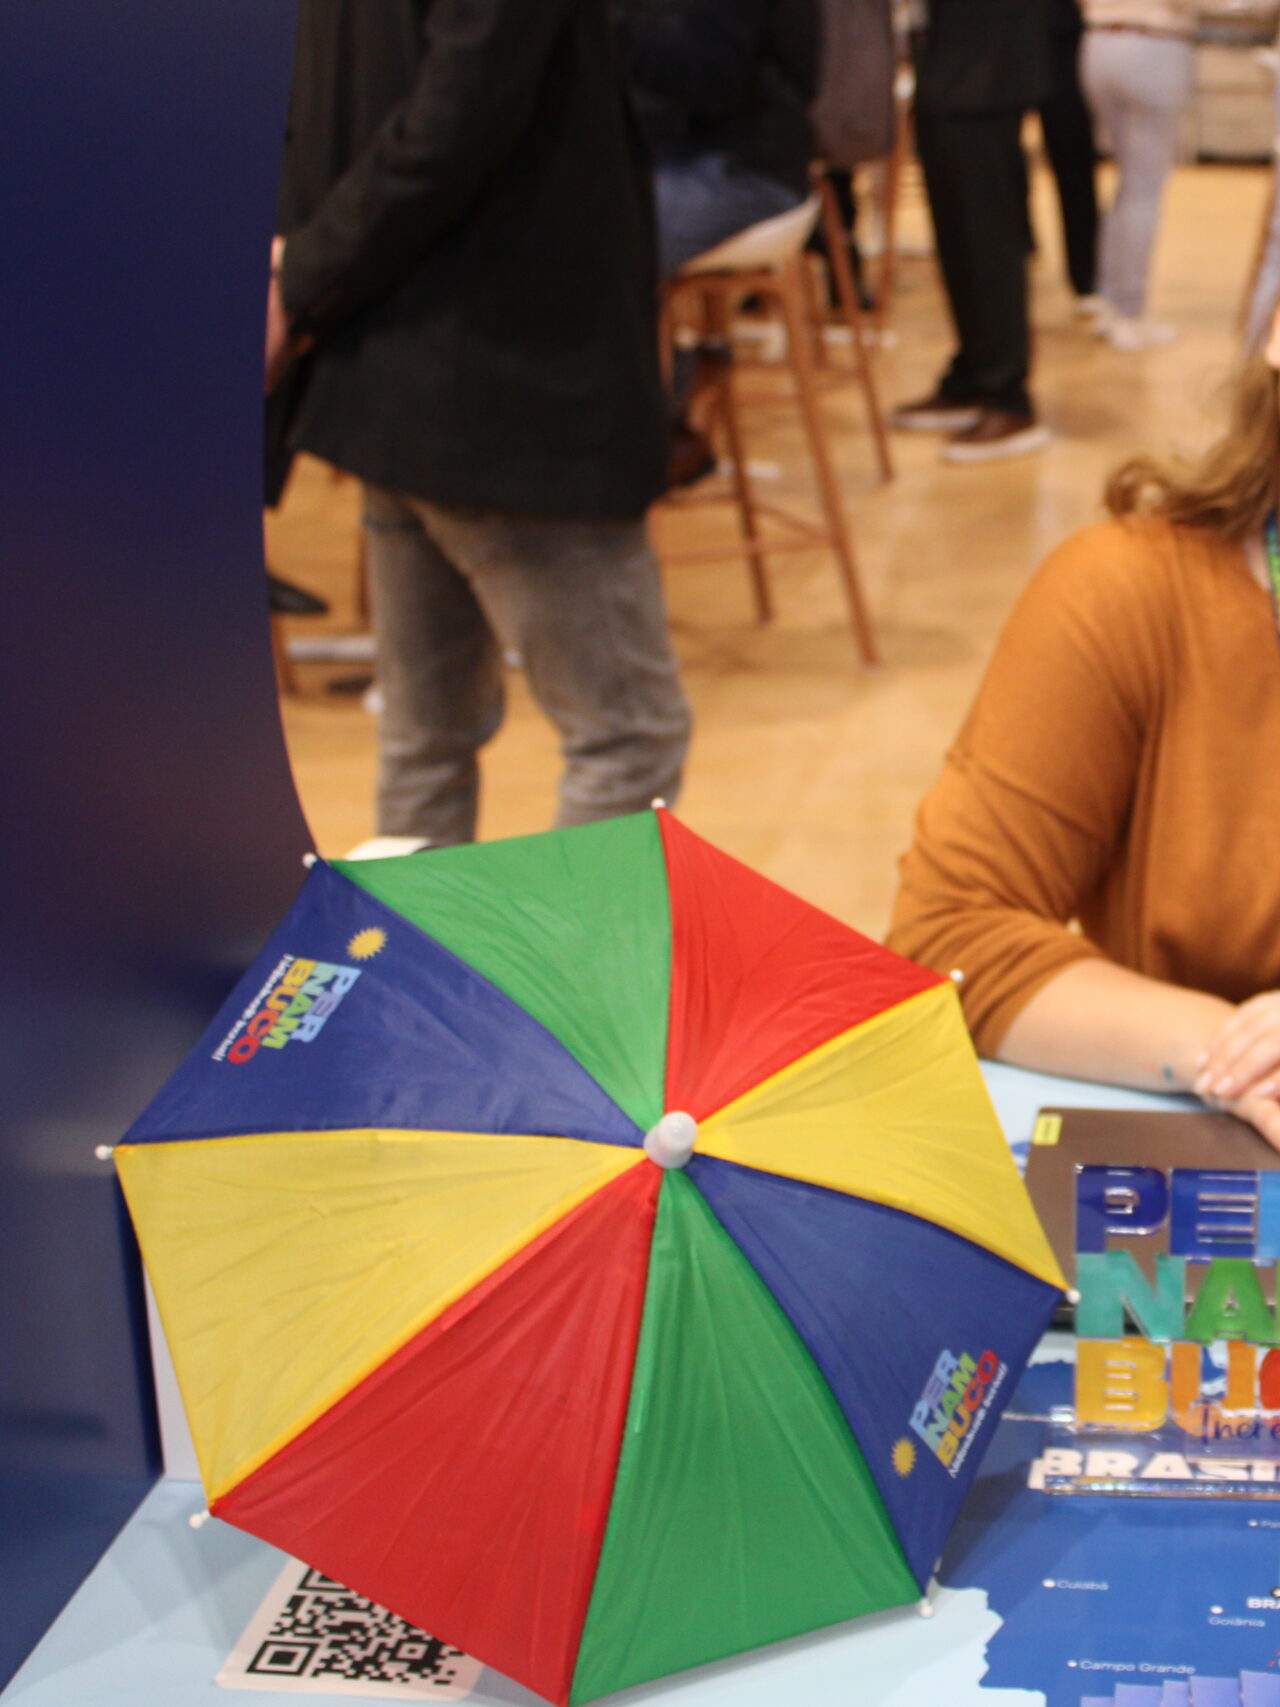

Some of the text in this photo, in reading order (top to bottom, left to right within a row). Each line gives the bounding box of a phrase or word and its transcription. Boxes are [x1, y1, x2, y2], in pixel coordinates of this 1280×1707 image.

[227, 958, 317, 1064] BUCO
[262, 961, 341, 1049] NAM
[290, 965, 362, 1042] PER
[908, 1349, 960, 1435] PER
[925, 1352, 977, 1450] NAM
[936, 1350, 999, 1468] BUCO
[1080, 1660, 1196, 1675] Campo Grande
